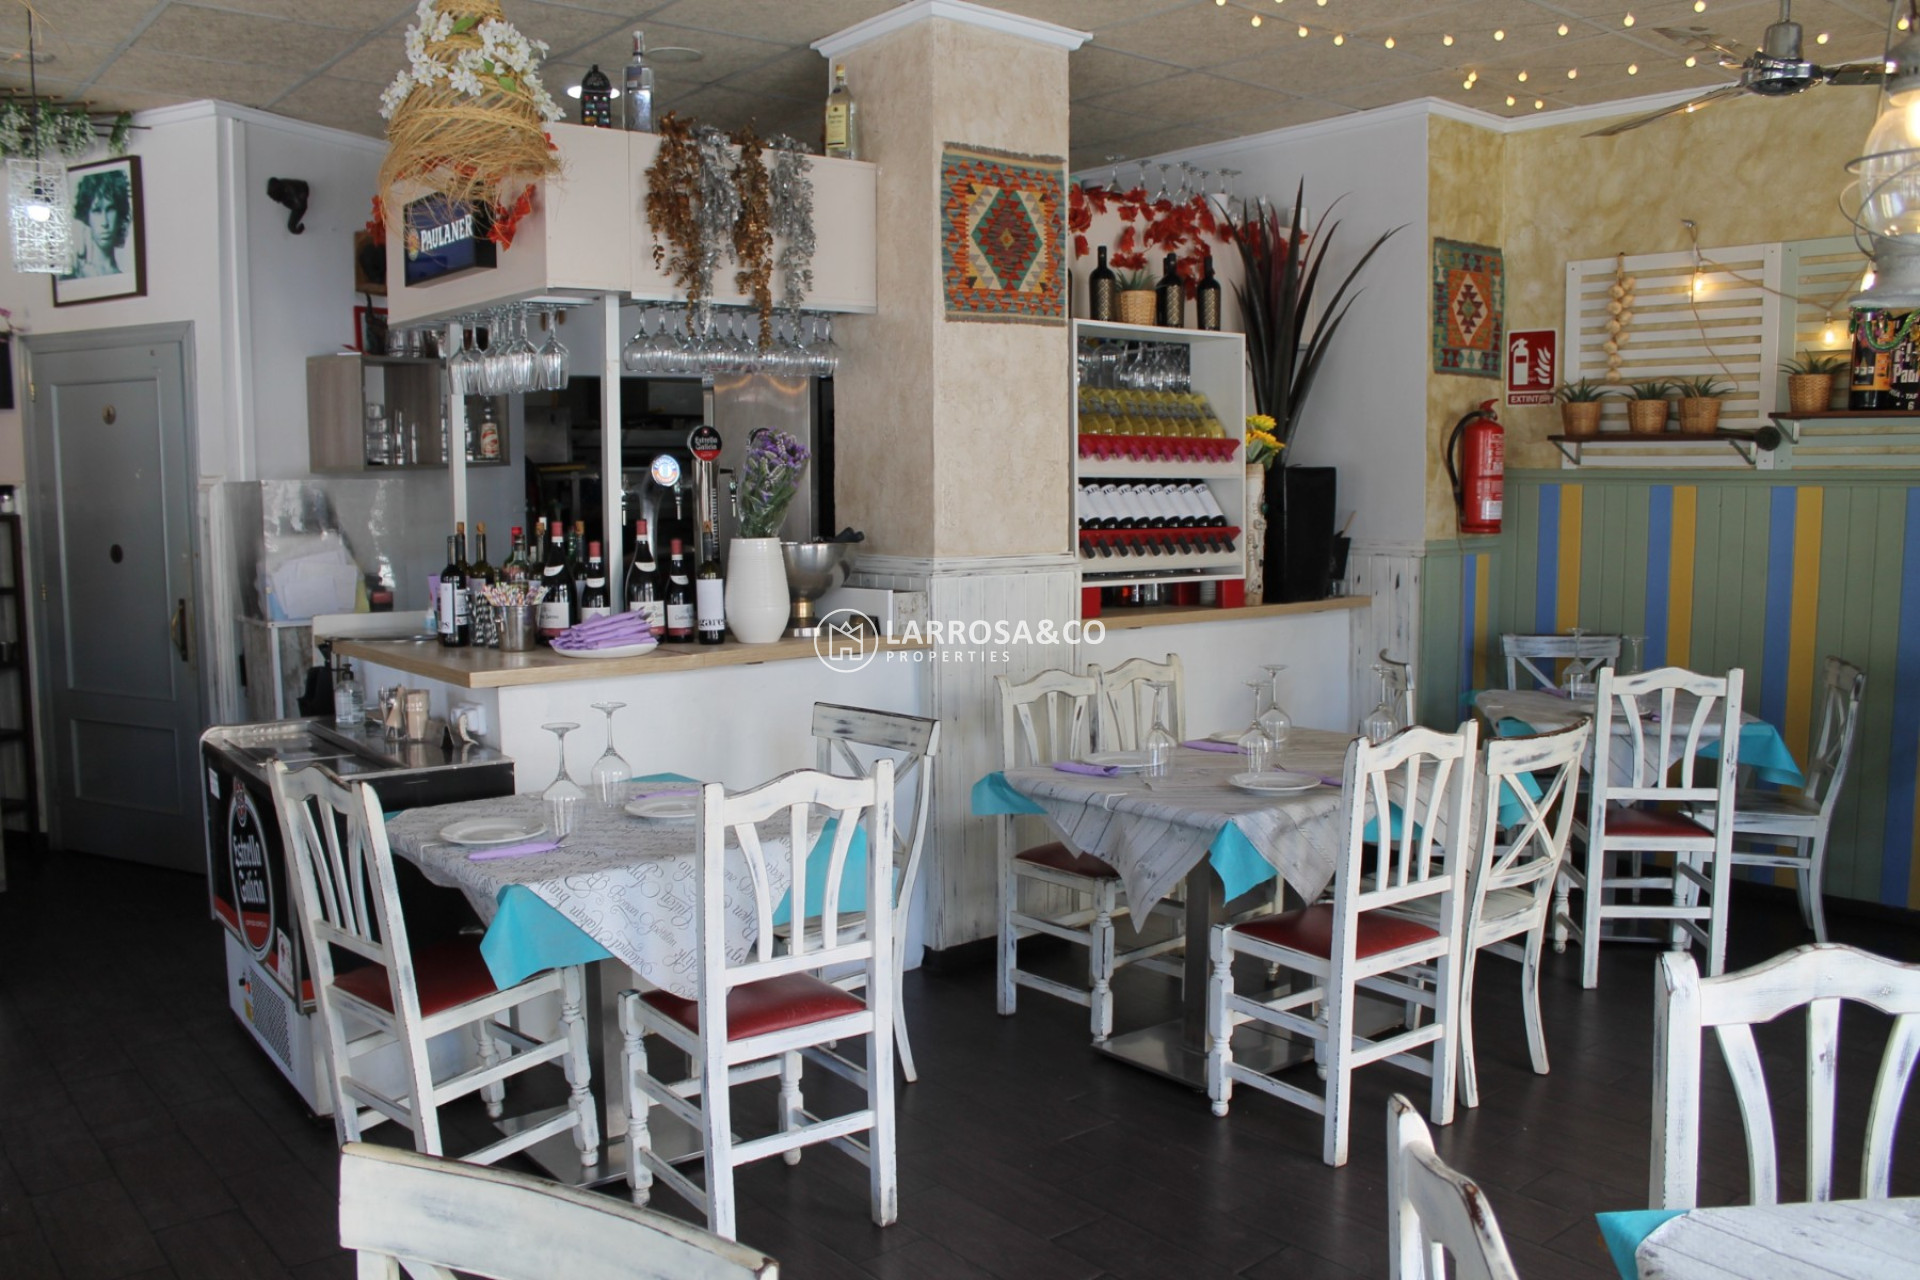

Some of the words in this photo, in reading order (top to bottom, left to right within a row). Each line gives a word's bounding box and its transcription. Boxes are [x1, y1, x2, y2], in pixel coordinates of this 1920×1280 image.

[420, 214, 473, 253] PAULANER
[233, 834, 261, 868] Estrella
[238, 870, 266, 904] Galicia
